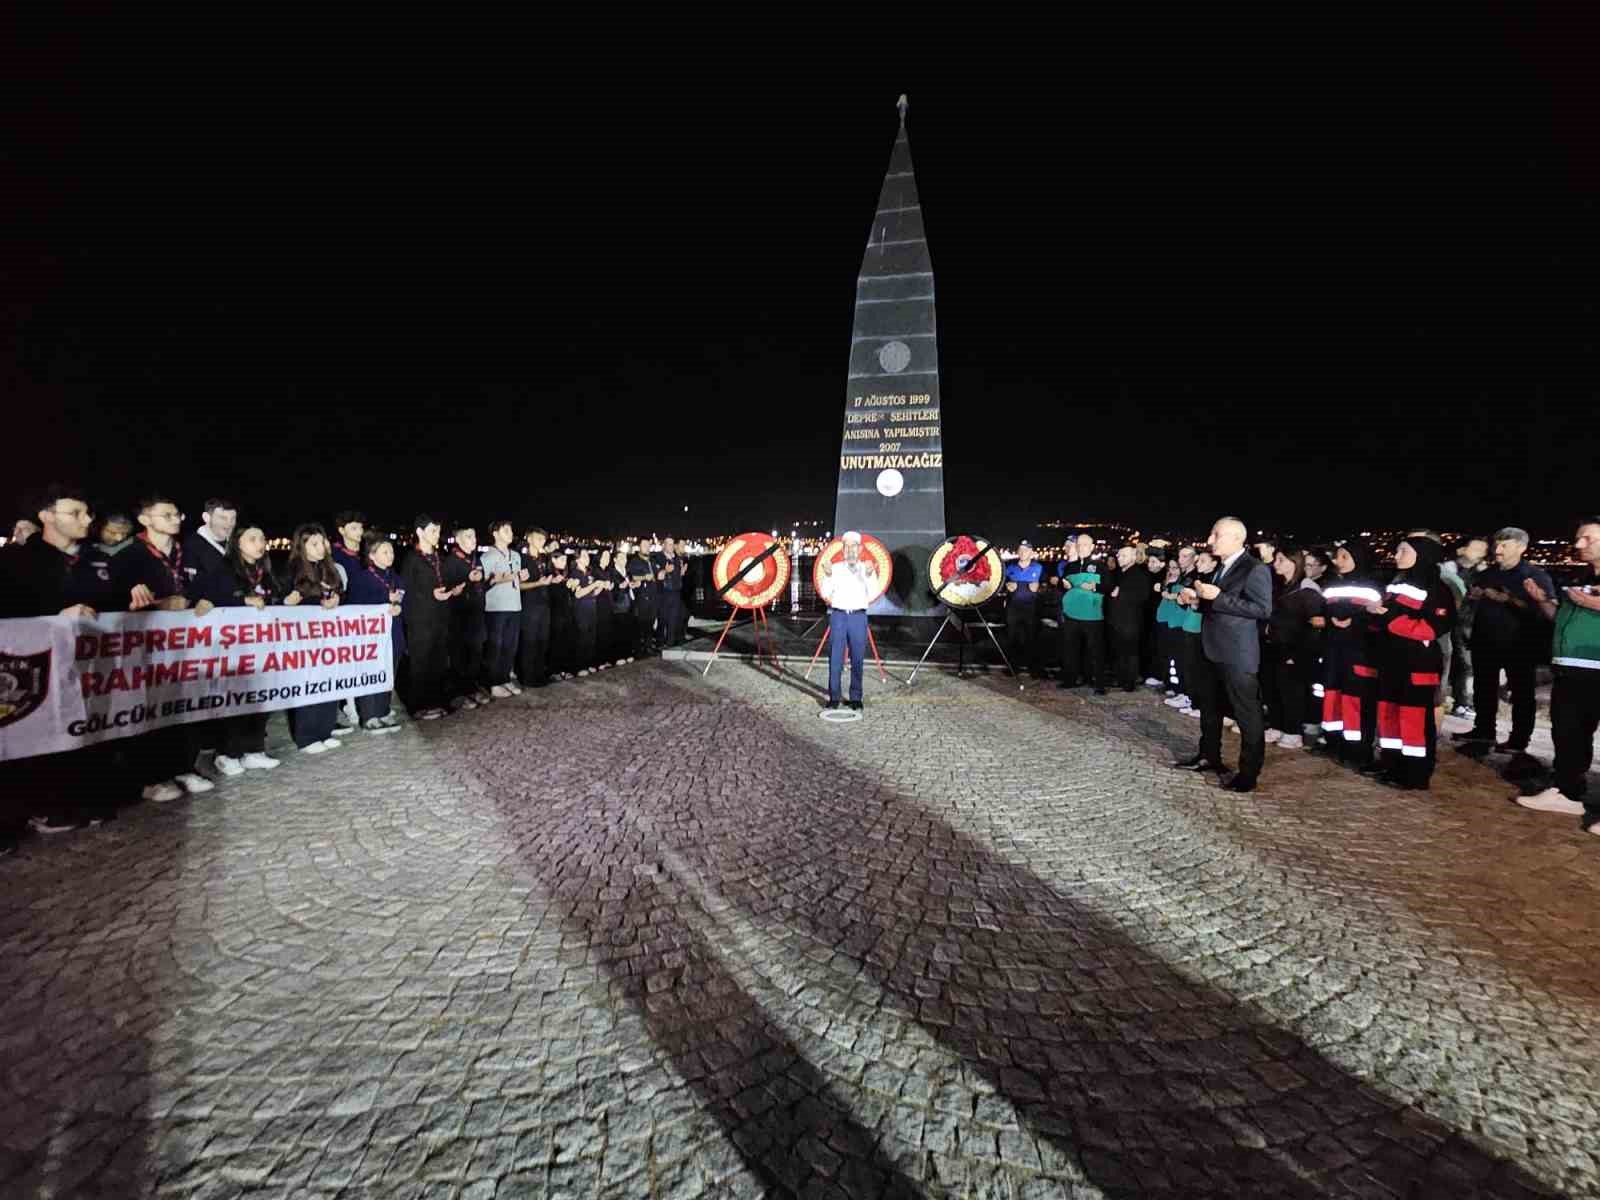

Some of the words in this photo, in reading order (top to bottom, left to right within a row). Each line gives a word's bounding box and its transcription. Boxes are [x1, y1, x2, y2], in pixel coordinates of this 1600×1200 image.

[853, 397, 862, 407] 17
[909, 394, 930, 404] 1999
[847, 412, 884, 423] DEPRE
[844, 429, 880, 440] ANISINA
[880, 443, 901, 452] 2007
[840, 452, 942, 469] UNUTMAYACAĞIZ
[75, 625, 212, 660] DEPREM
[219, 614, 386, 649] ŞEHİTLERİMİZİ
[81, 653, 256, 698] RAHMETLE
[262, 643, 378, 672] ANIYORUZ
[67, 703, 157, 737] GÖLCÜK
[161, 685, 301, 717] BELEDİYESPOR
[305, 677, 332, 695] İZCİ
[335, 671, 387, 690] KULÜBÜ
